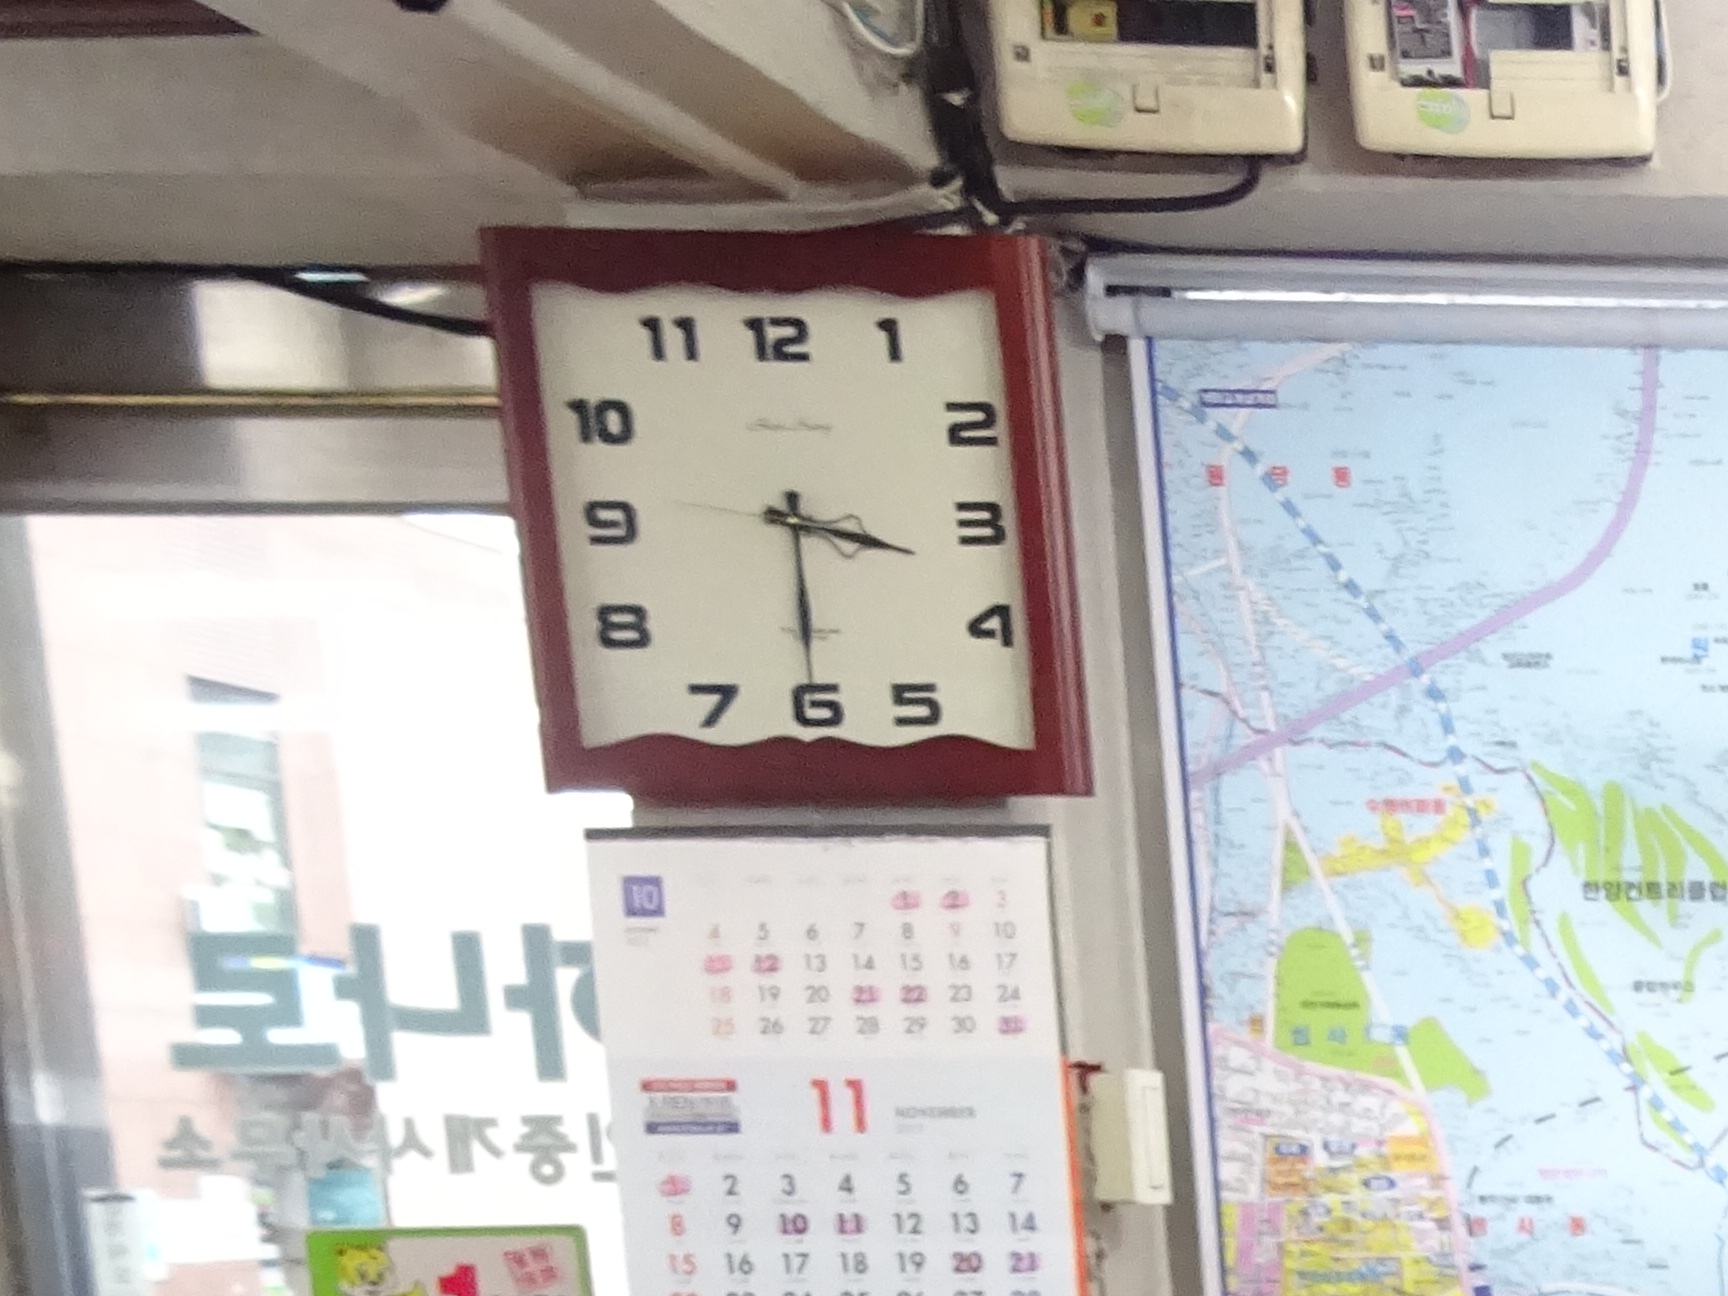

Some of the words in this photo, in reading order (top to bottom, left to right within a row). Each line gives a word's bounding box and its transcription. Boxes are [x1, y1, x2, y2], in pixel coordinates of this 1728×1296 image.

[640, 317, 699, 361] 11
[744, 317, 811, 361] 12
[876, 317, 903, 362] 1
[567, 399, 634, 443] 10
[946, 403, 997, 446] 2
[585, 500, 637, 545] 9
[956, 502, 1004, 546] 3
[596, 605, 651, 648] 8
[968, 605, 1012, 648] 4
[689, 685, 738, 728] 7
[792, 684, 844, 727] 6
[891, 684, 941, 727] 5
[632, 885, 658, 909] 10
[1582, 880, 1728, 903] 한양컨트리클럽
[811, 1078, 870, 1134] 11
[722, 1173, 739, 1196] 2
[782, 1173, 797, 1196] 3
[838, 1173, 854, 1196] 4
[898, 1173, 912, 1196] 5
[953, 1173, 969, 1196] 6
[1010, 1173, 1025, 1196] 7
[670, 1212, 685, 1235] 8
[726, 1212, 742, 1235] 9
[780, 1212, 809, 1235] 10
[837, 1212, 863, 1235] 11
[894, 1212, 923, 1235] 12
[951, 1212, 979, 1235] 13
[1009, 1212, 1037, 1235] 14
[669, 1252, 698, 1275] 15
[726, 1252, 754, 1275] 16
[783, 1252, 809, 1275] 17
[840, 1252, 869, 1275] 18
[897, 1252, 926, 1275] 19
[953, 1252, 983, 1275] 20
[1010, 1252, 1038, 1275] 21
